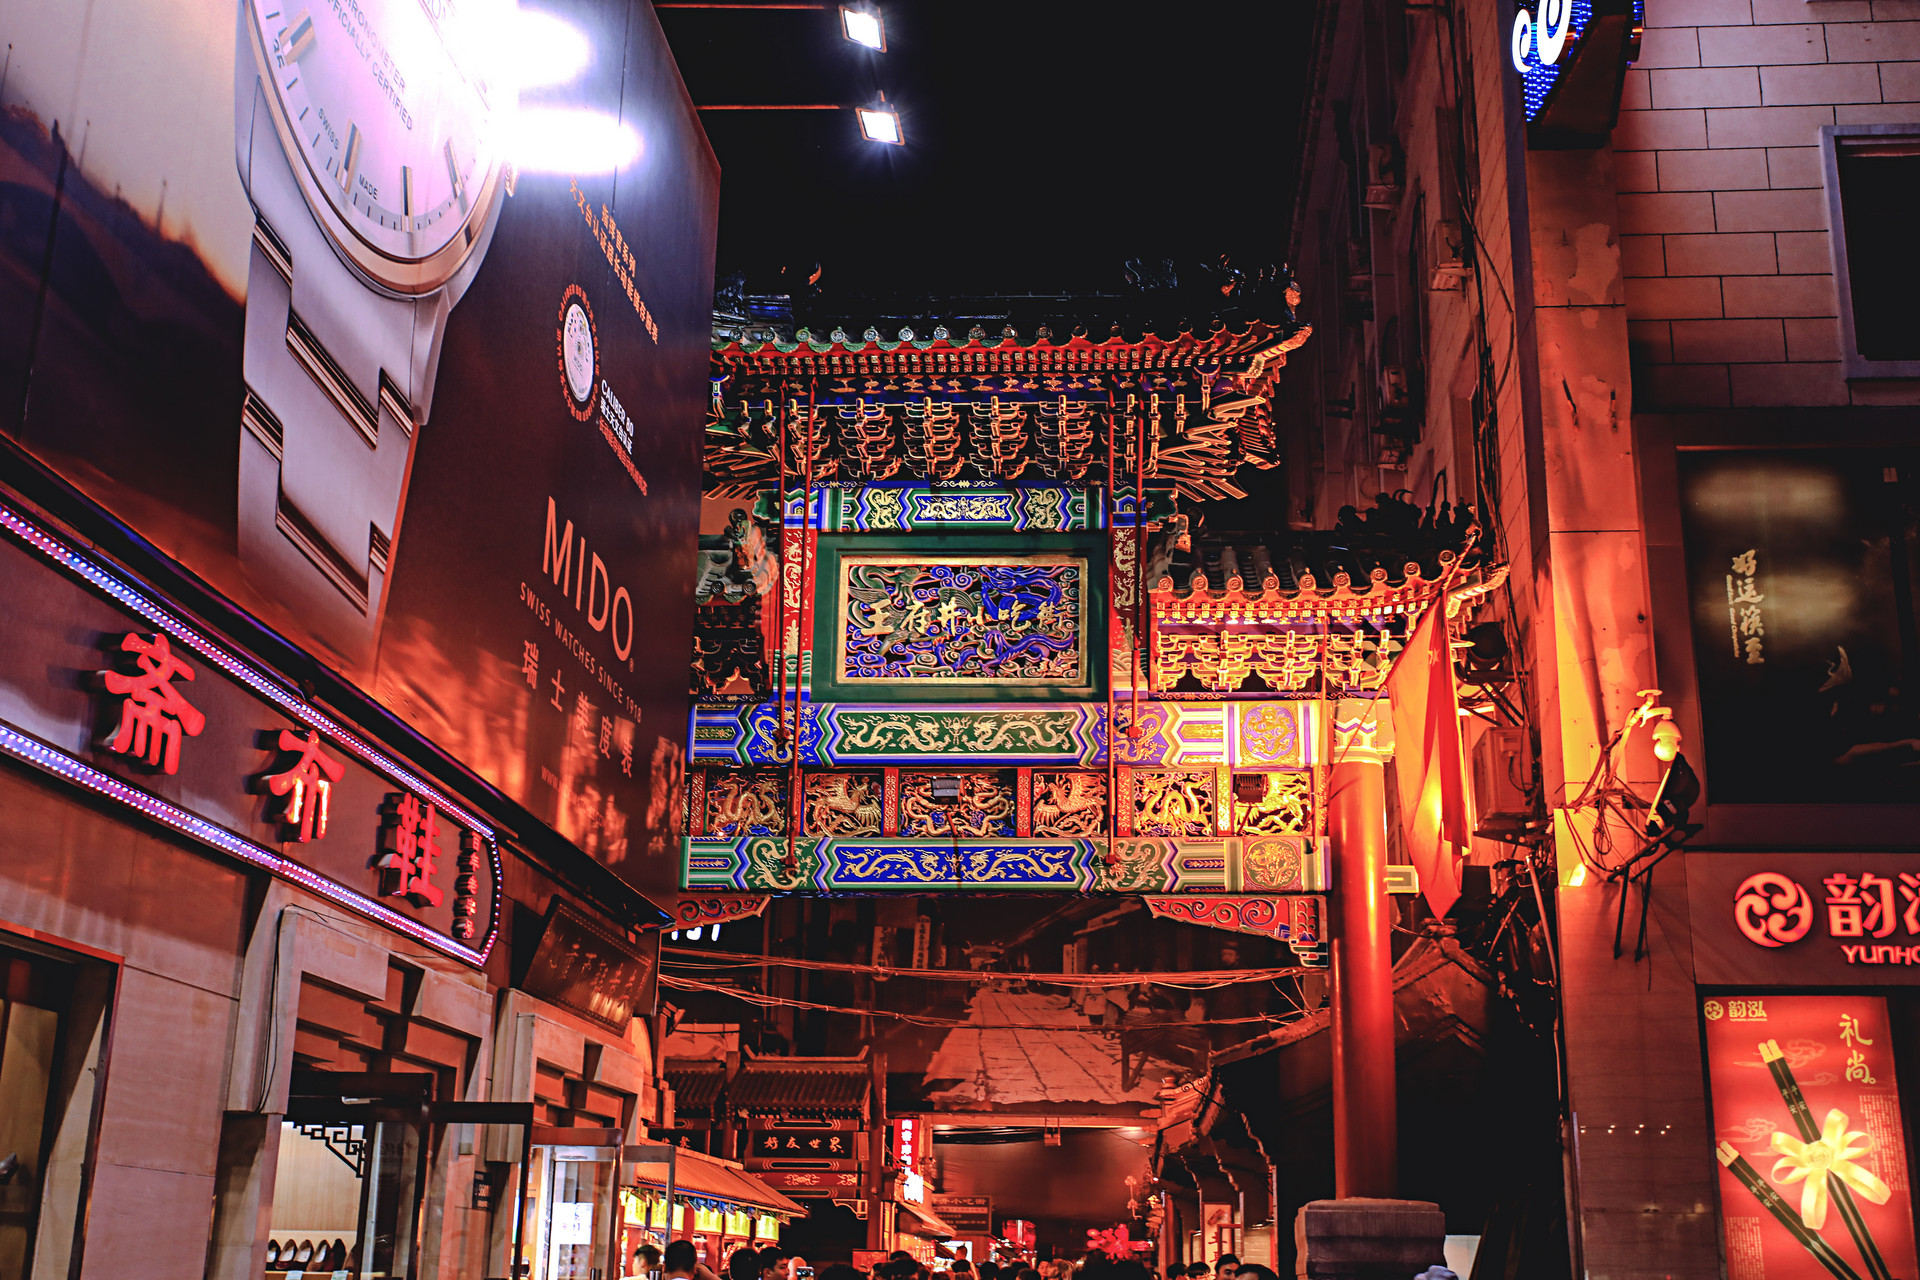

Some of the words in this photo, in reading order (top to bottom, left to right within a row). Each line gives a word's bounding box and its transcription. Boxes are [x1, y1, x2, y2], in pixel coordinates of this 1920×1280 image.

[372, 62, 413, 131] CERTIFIED
[358, 173, 378, 200] MADE
[601, 378, 626, 427] CALIBER
[542, 495, 634, 663] MIDO
[860, 596, 1066, 637] 王府井小吃街
[519, 581, 552, 628] SWISS
[554, 617, 596, 675] WATCHES
[598, 665, 624, 705] SINCE
[626, 695, 643, 724] 1918
[764, 1136, 845, 1154] 好友世界
